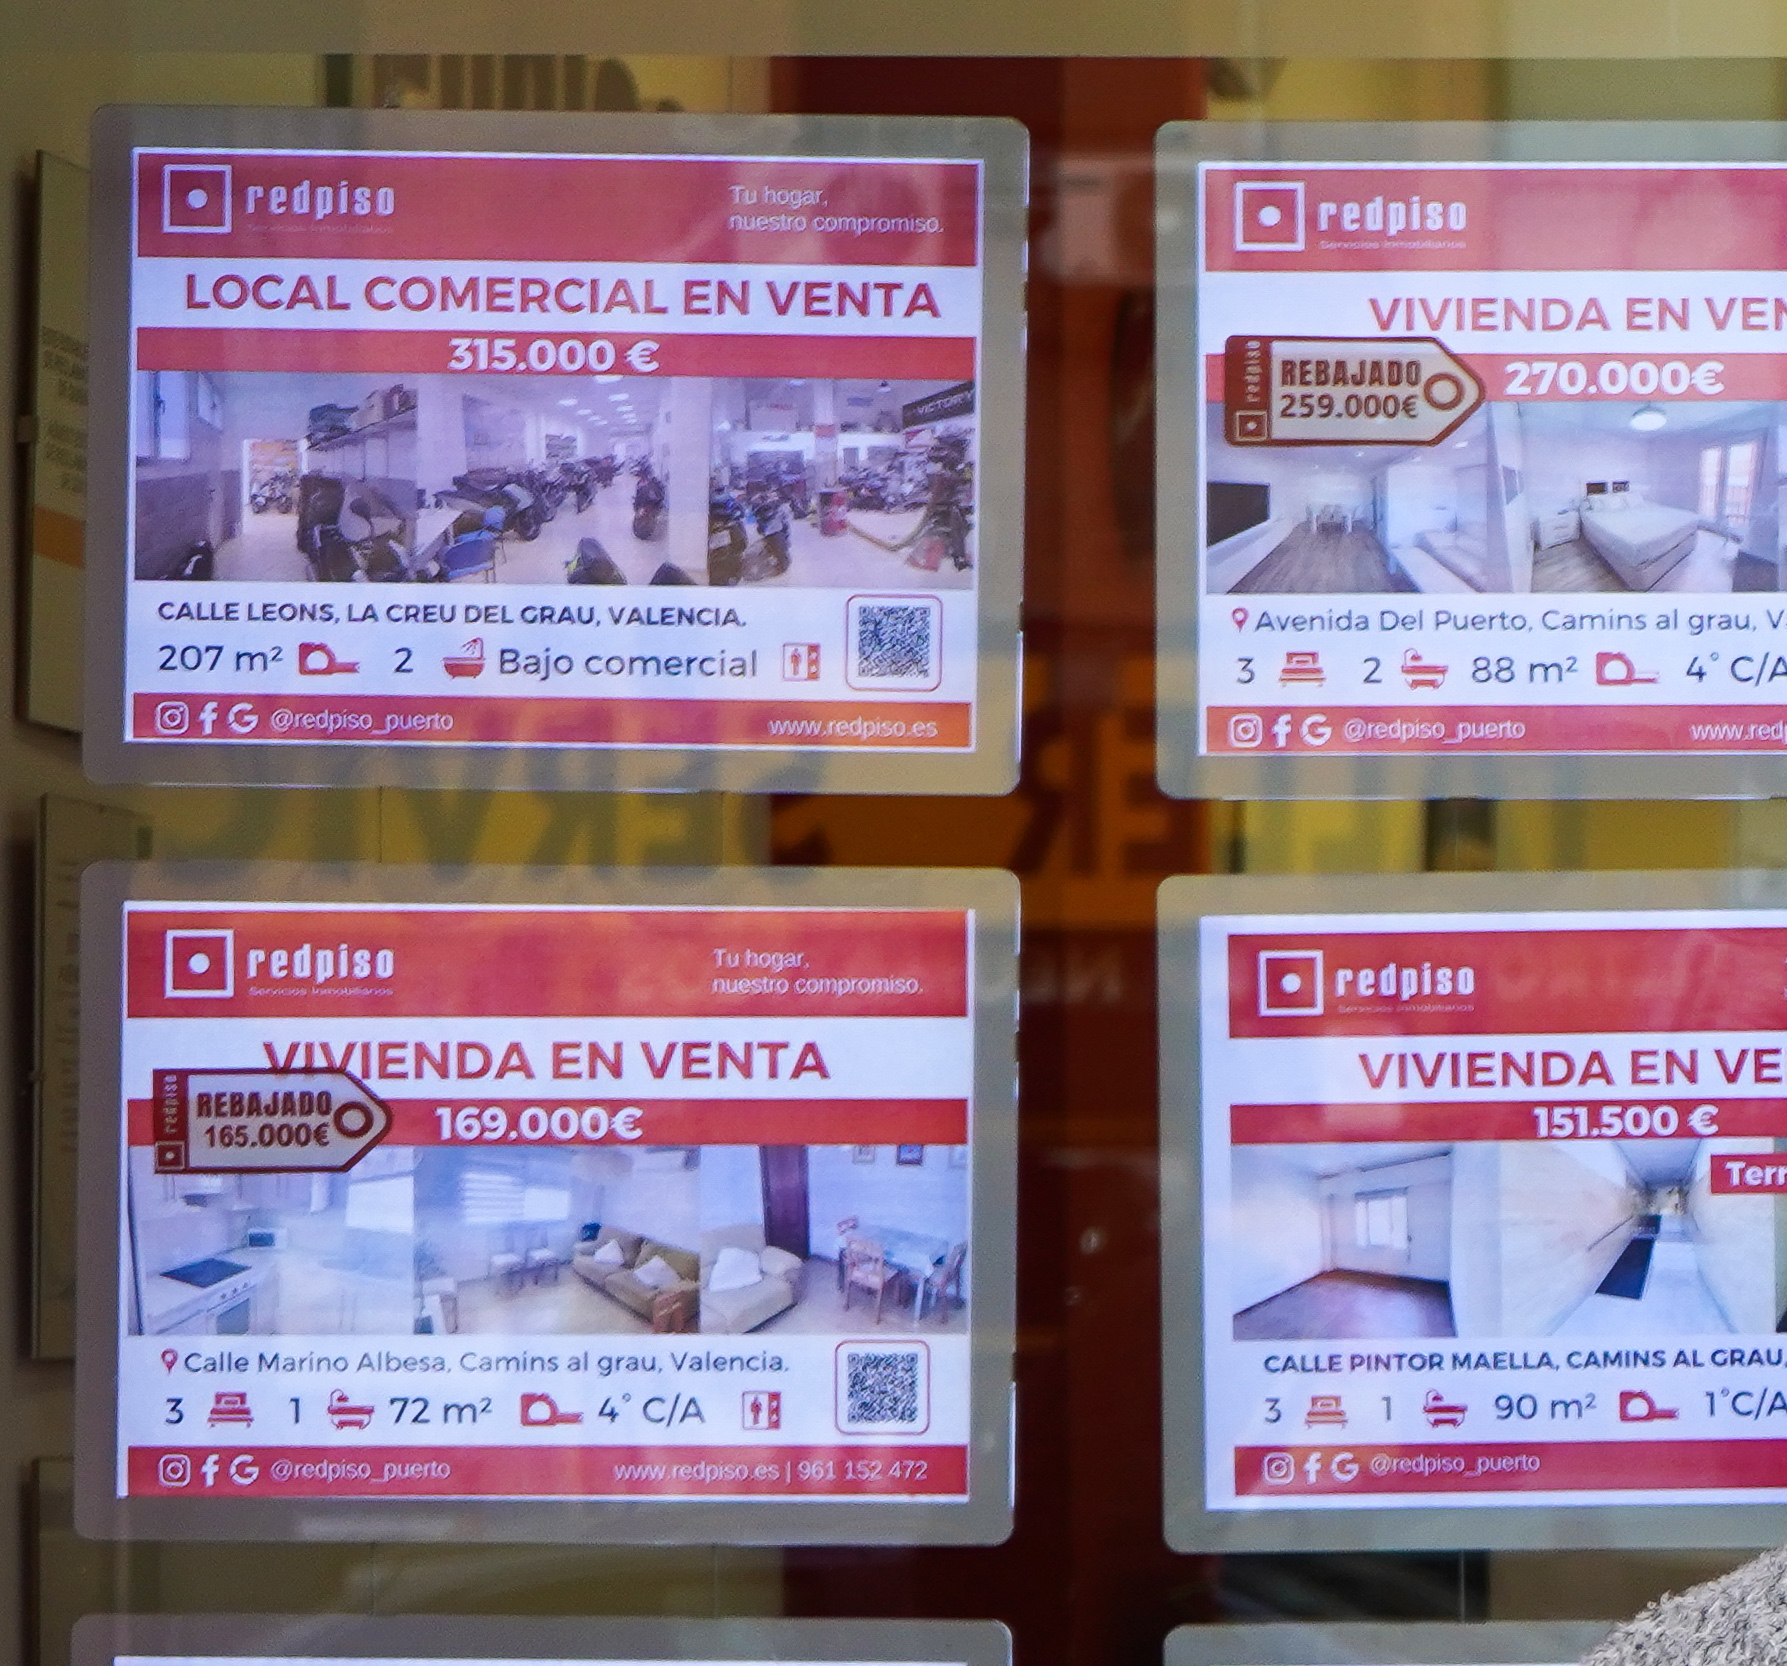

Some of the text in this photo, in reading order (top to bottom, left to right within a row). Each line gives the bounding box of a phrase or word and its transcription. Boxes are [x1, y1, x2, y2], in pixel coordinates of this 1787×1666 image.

[246, 180, 395, 221] redpiso
[185, 273, 941, 319] LOCAL COMERCIAL EN VENTA
[1368, 296, 1611, 332] VIVIENDA
[1626, 297, 1690, 332] EN
[447, 338, 661, 374] 315.000 €
[1280, 359, 1421, 387] REBAJADO
[1505, 360, 1725, 395] 270.000€
[1279, 393, 1418, 419] 259.000€
[157, 601, 240, 622] CALLE
[347, 603, 379, 623] LA
[385, 603, 457, 624] CREU
[464, 604, 514, 625] DEL
[1253, 608, 1370, 633] Avenida
[1379, 609, 1424, 632] Del
[1541, 609, 1648, 632] Camins
[1655, 608, 1679, 631] al
[499, 646, 757, 682] Bajo comercial
[269, 708, 454, 735] @redpiso_puerto
[259, 1041, 830, 1081] VIVIENDA EN VENTA
[1358, 1050, 1615, 1089] VIVIENDA
[1630, 1049, 1699, 1085] EN
[196, 1090, 337, 1123] REBAJADO
[436, 1106, 644, 1140] 169.000€
[1533, 1104, 1720, 1139] 151.500 €
[204, 1122, 330, 1148] 165.000€
[1263, 1353, 1342, 1374] CALLE
[1349, 1352, 1444, 1372] PINTOR
[1566, 1349, 1667, 1370] CAMINS
[1672, 1349, 1705, 1368] AL
